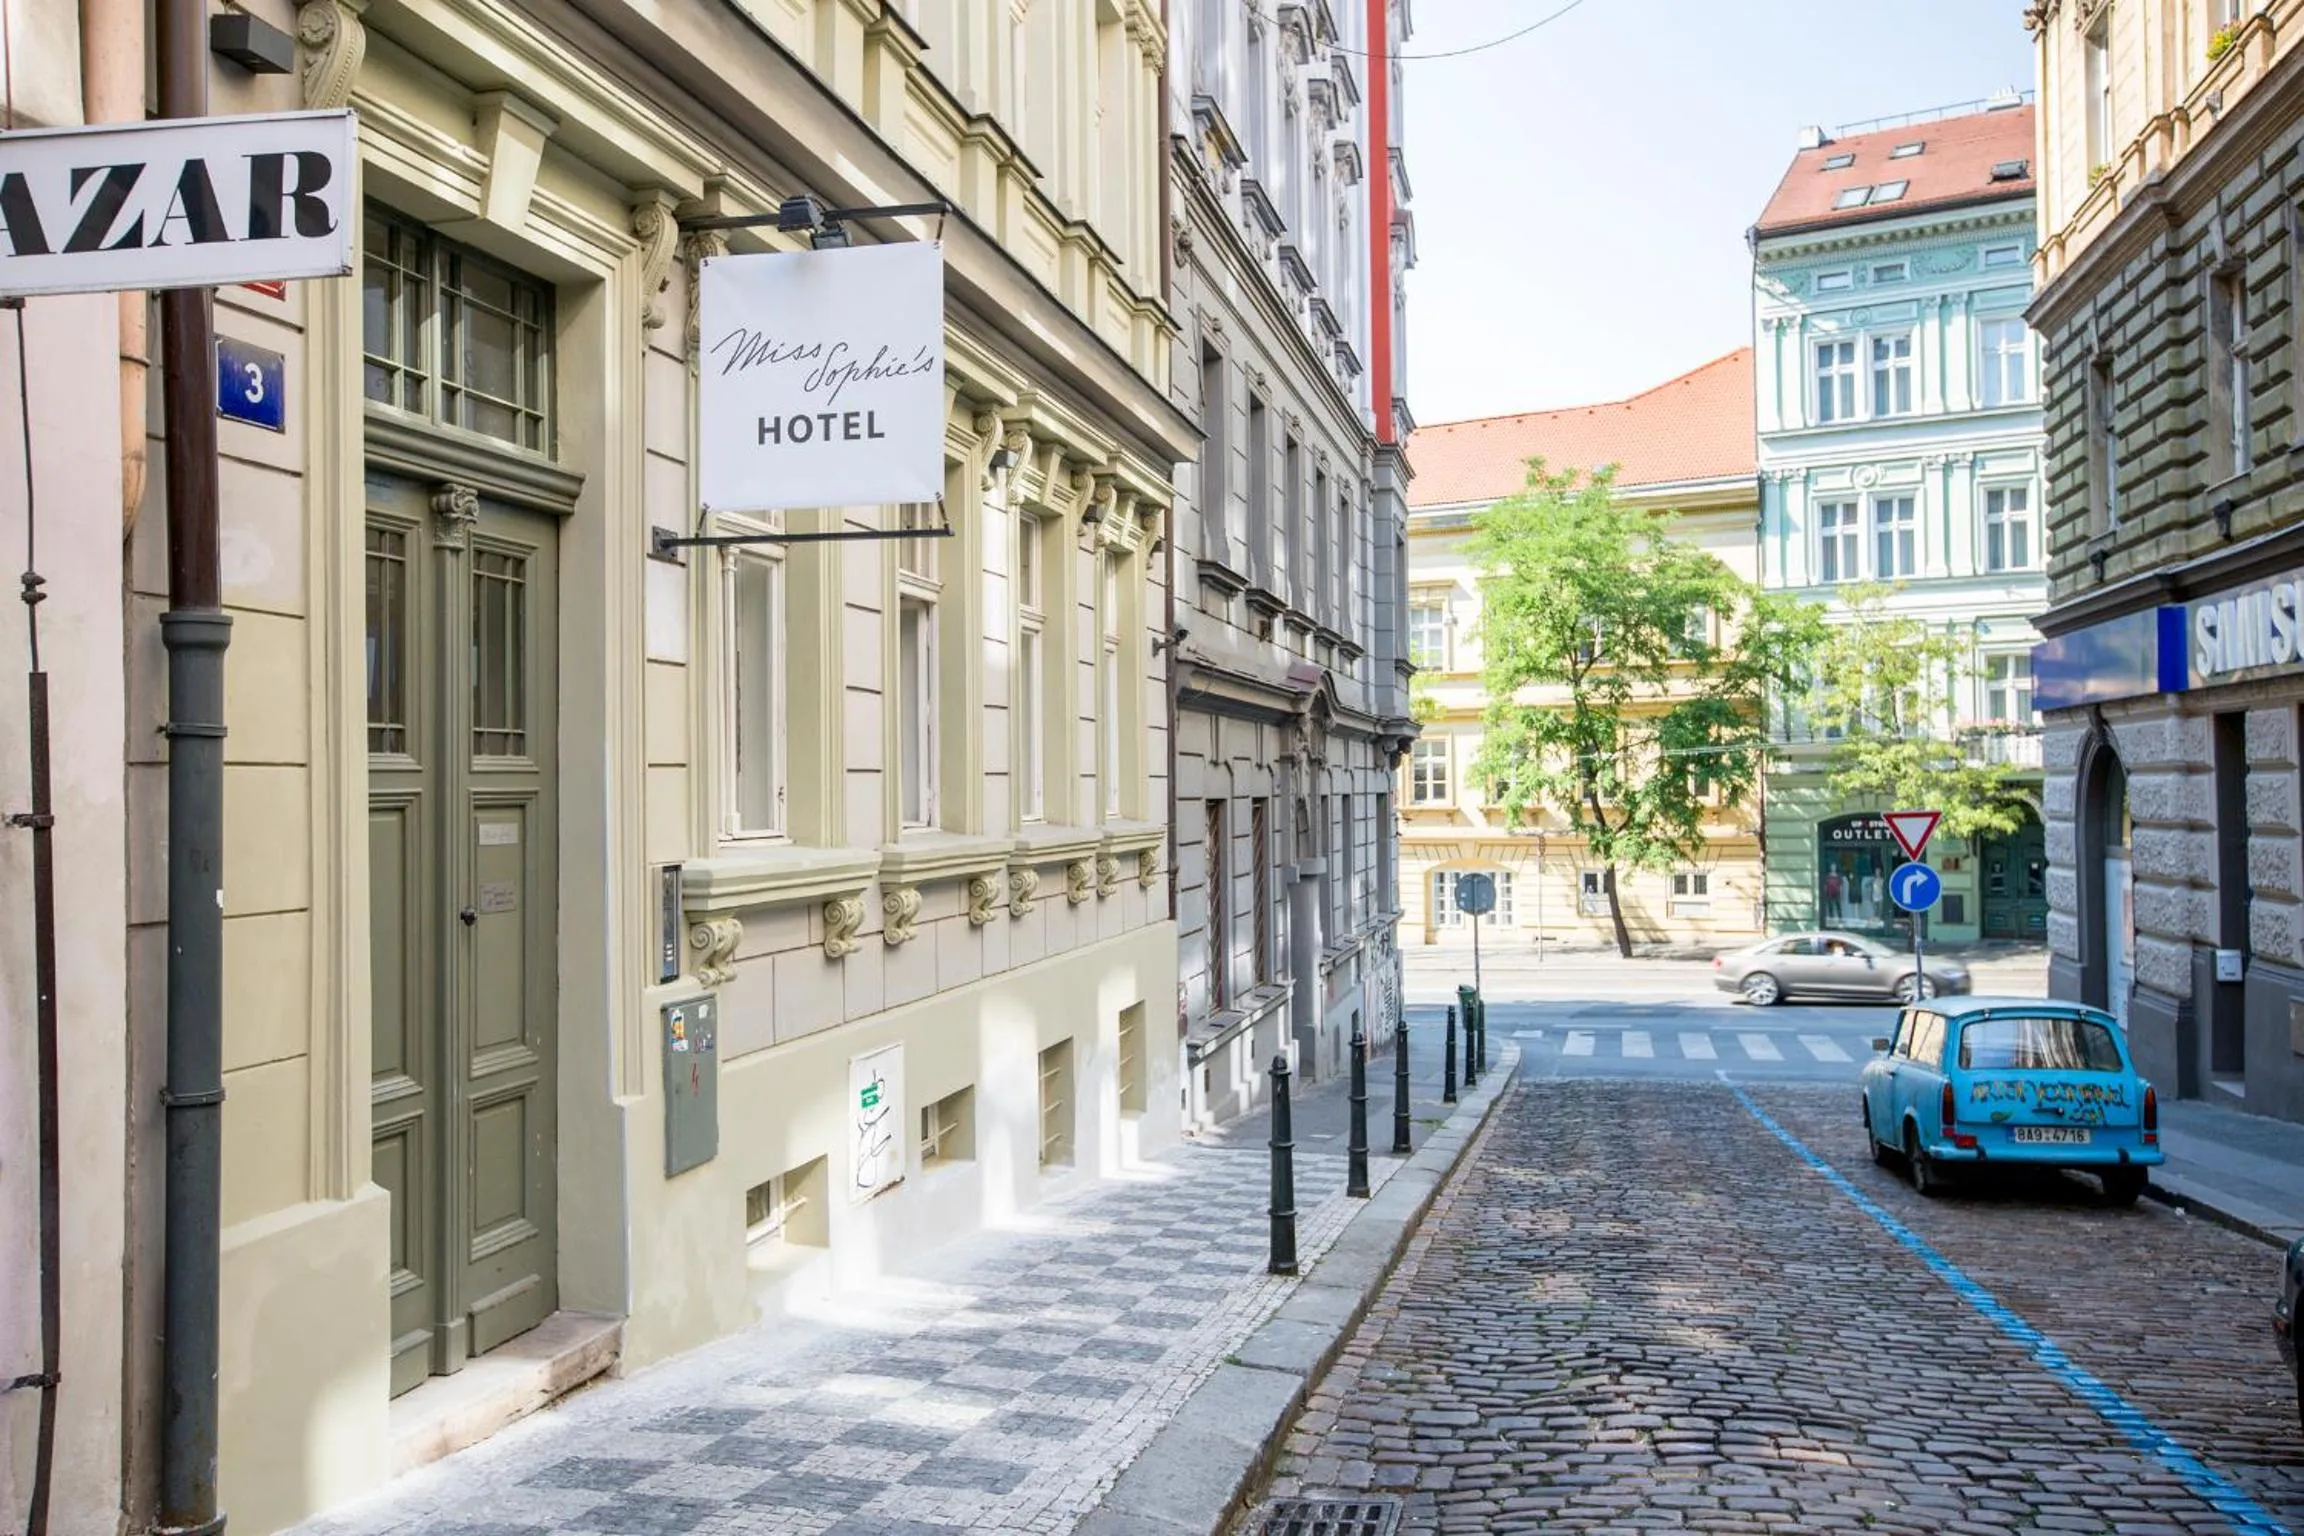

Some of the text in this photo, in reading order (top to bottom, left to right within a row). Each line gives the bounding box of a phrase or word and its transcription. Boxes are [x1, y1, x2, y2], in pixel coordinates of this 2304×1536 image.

[244, 362, 265, 404] 3
[710, 328, 935, 407] Miss Sophie's
[757, 410, 886, 446] HOTEL
[1832, 829, 1892, 840] OUTLET
